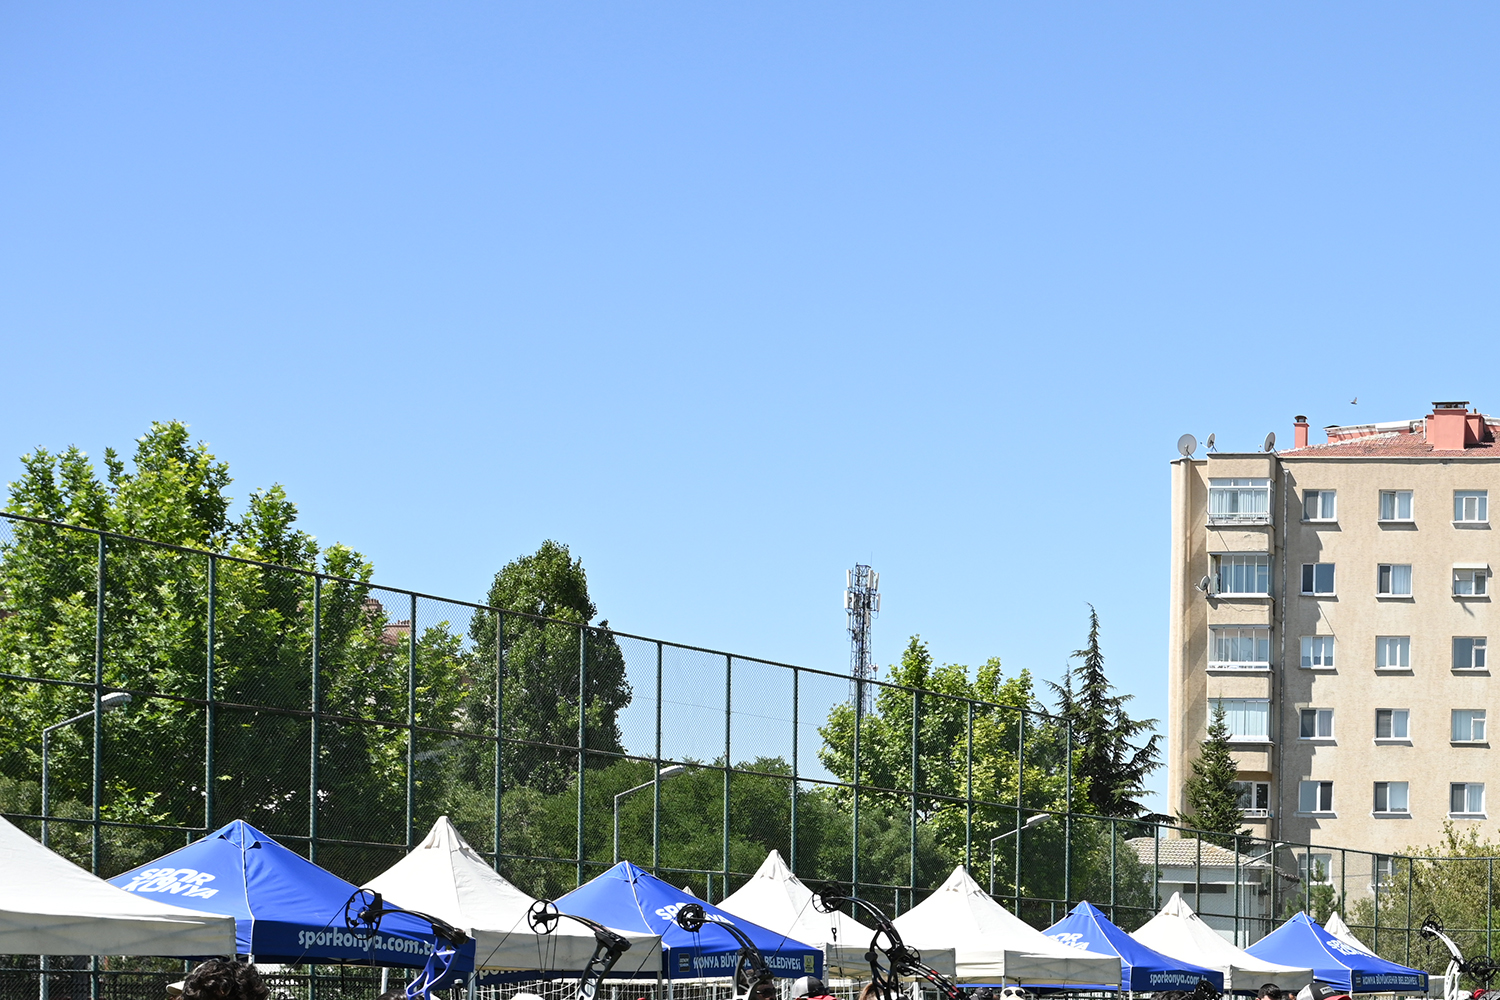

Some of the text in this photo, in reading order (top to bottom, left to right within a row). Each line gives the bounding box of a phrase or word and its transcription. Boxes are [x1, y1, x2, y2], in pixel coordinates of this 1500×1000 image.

[132, 868, 216, 886] SPOR
[120, 879, 219, 899] KONYA
[693, 956, 719, 969] KONYA
